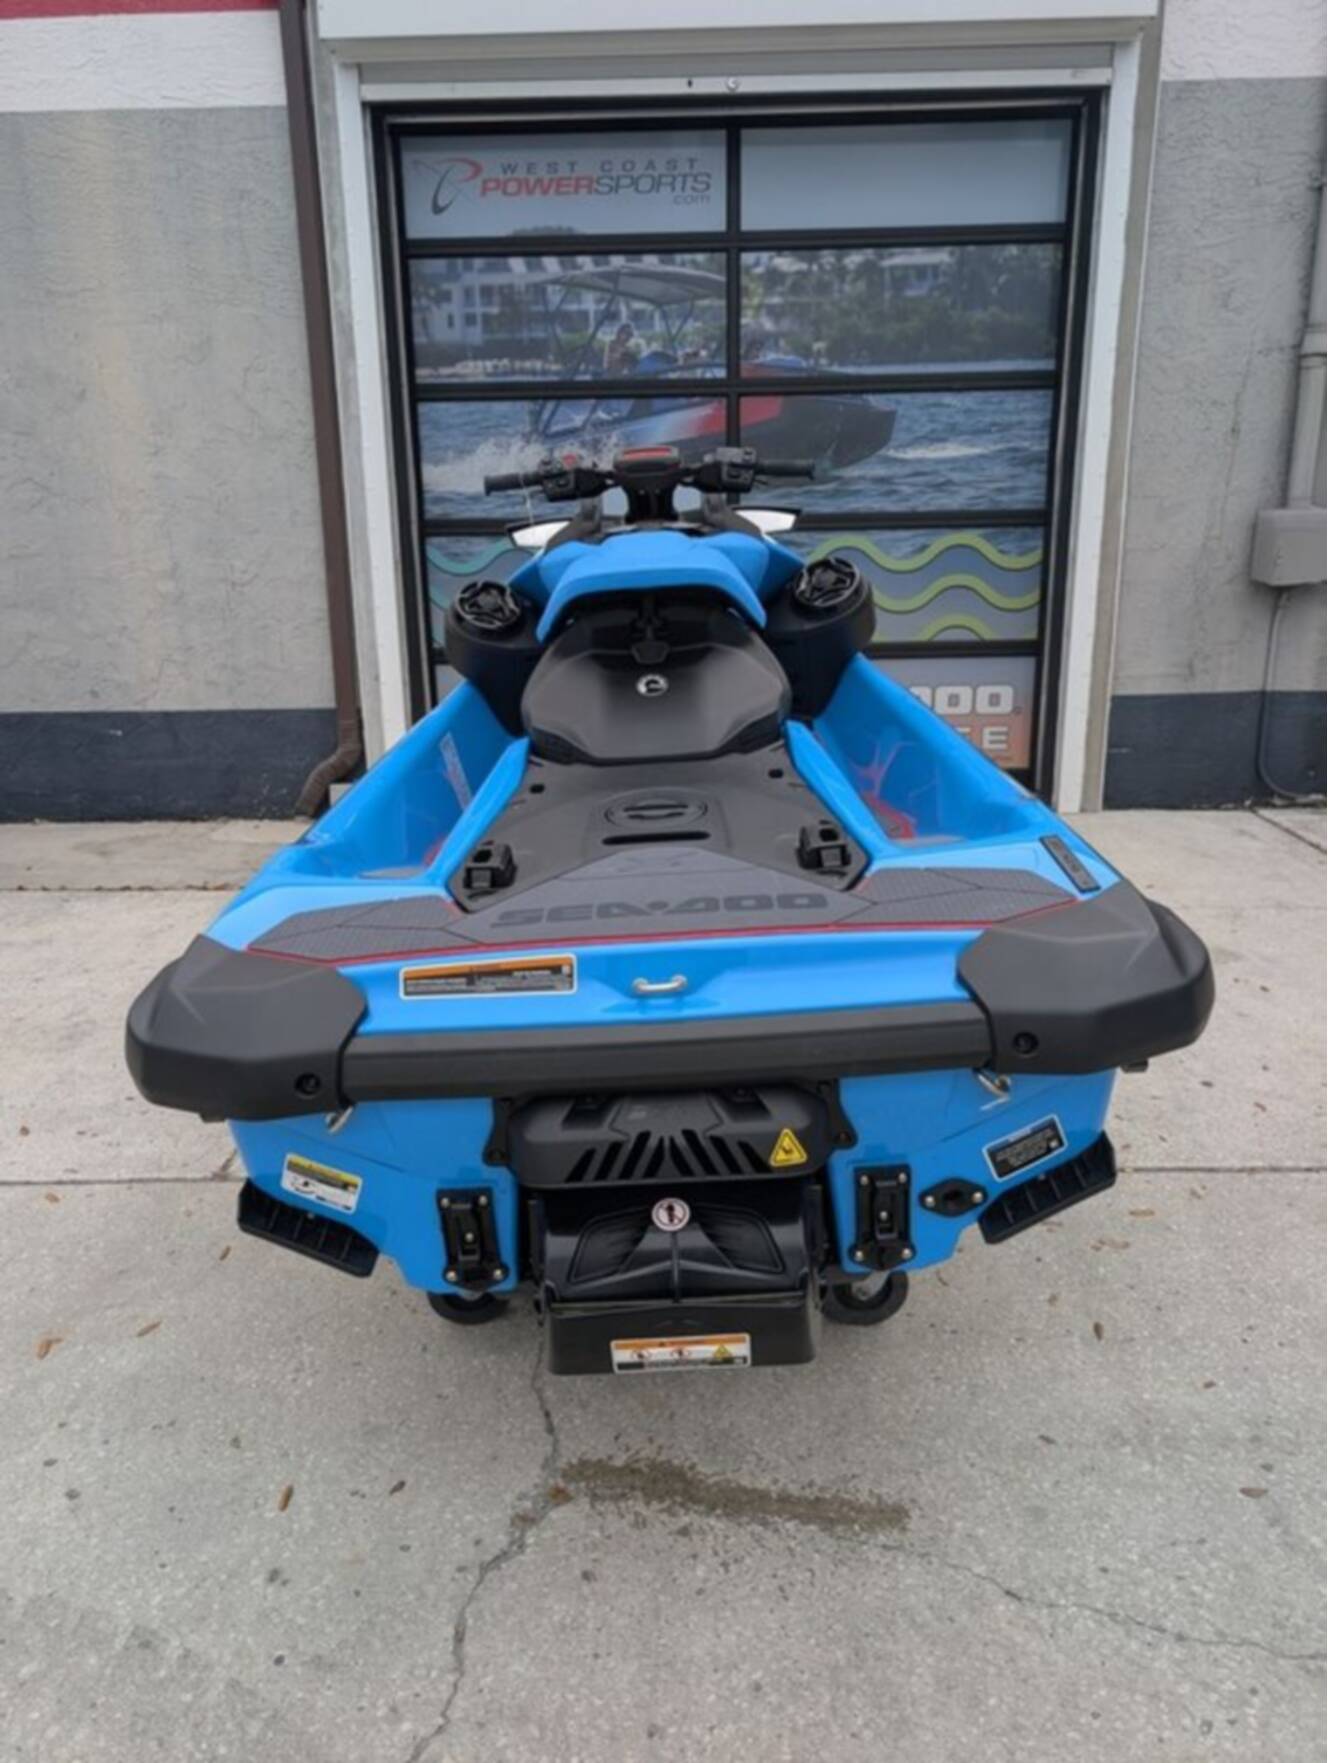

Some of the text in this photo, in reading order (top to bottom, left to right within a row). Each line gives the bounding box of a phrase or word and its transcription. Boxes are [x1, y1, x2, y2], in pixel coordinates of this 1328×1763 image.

[501, 157, 698, 175] WEST COAST
[480, 171, 712, 198] POWERSPORTS
